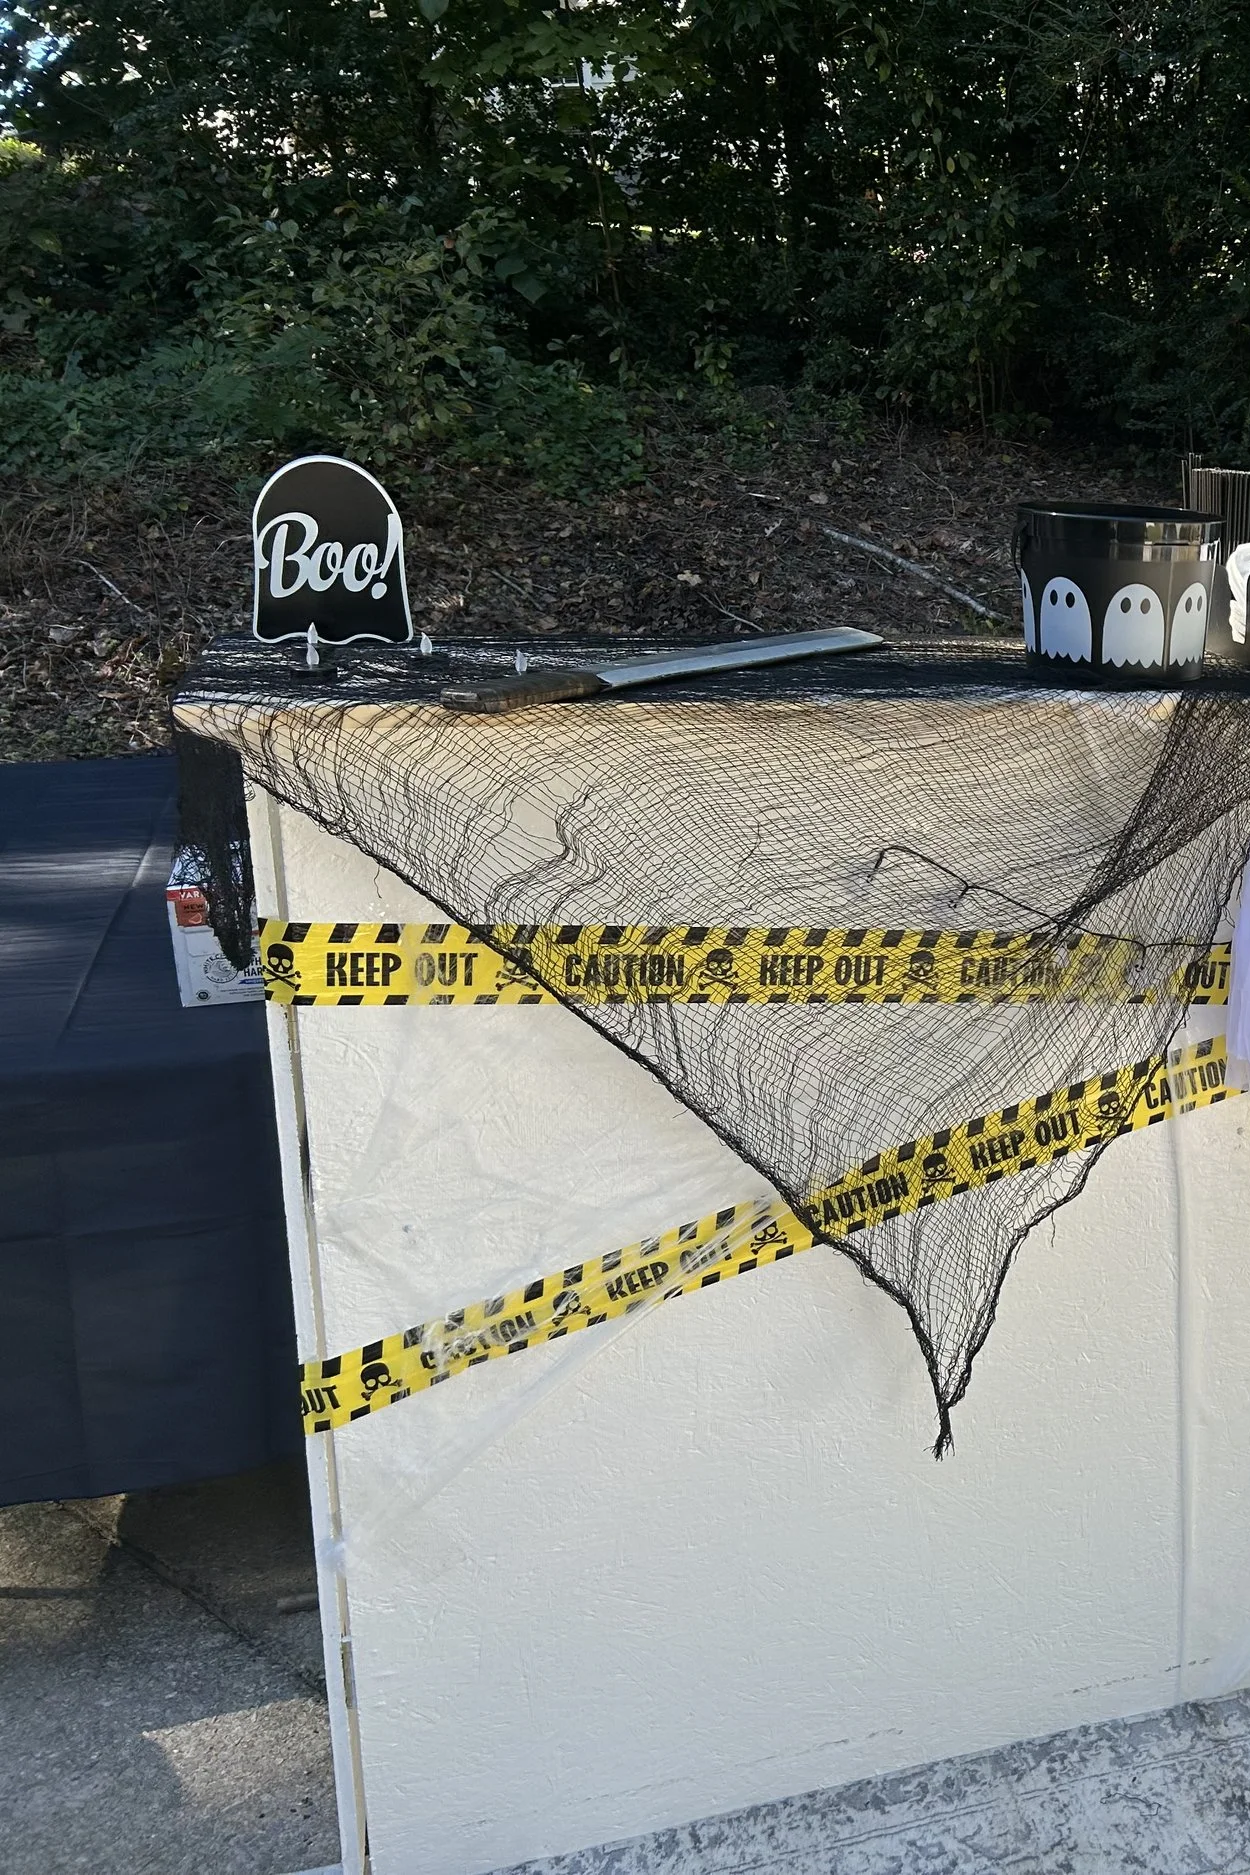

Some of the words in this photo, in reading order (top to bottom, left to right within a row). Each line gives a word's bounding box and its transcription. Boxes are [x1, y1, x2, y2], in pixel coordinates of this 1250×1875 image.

[257, 512, 402, 600] Boo!
[179, 890, 204, 899] VAR
[243, 966, 264, 977] HAR
[326, 951, 402, 987] KEEP
[414, 951, 479, 987] OUT
[564, 953, 685, 988] CAUTION
[759, 954, 824, 987] KEEP
[834, 955, 890, 988] OUT
[1184, 961, 1231, 990] OUT
[605, 1261, 669, 1302] KEEP
[807, 1170, 909, 1230] CAUTION
[969, 1130, 1026, 1171] KEEP
[1034, 1108, 1082, 1147] OUT
